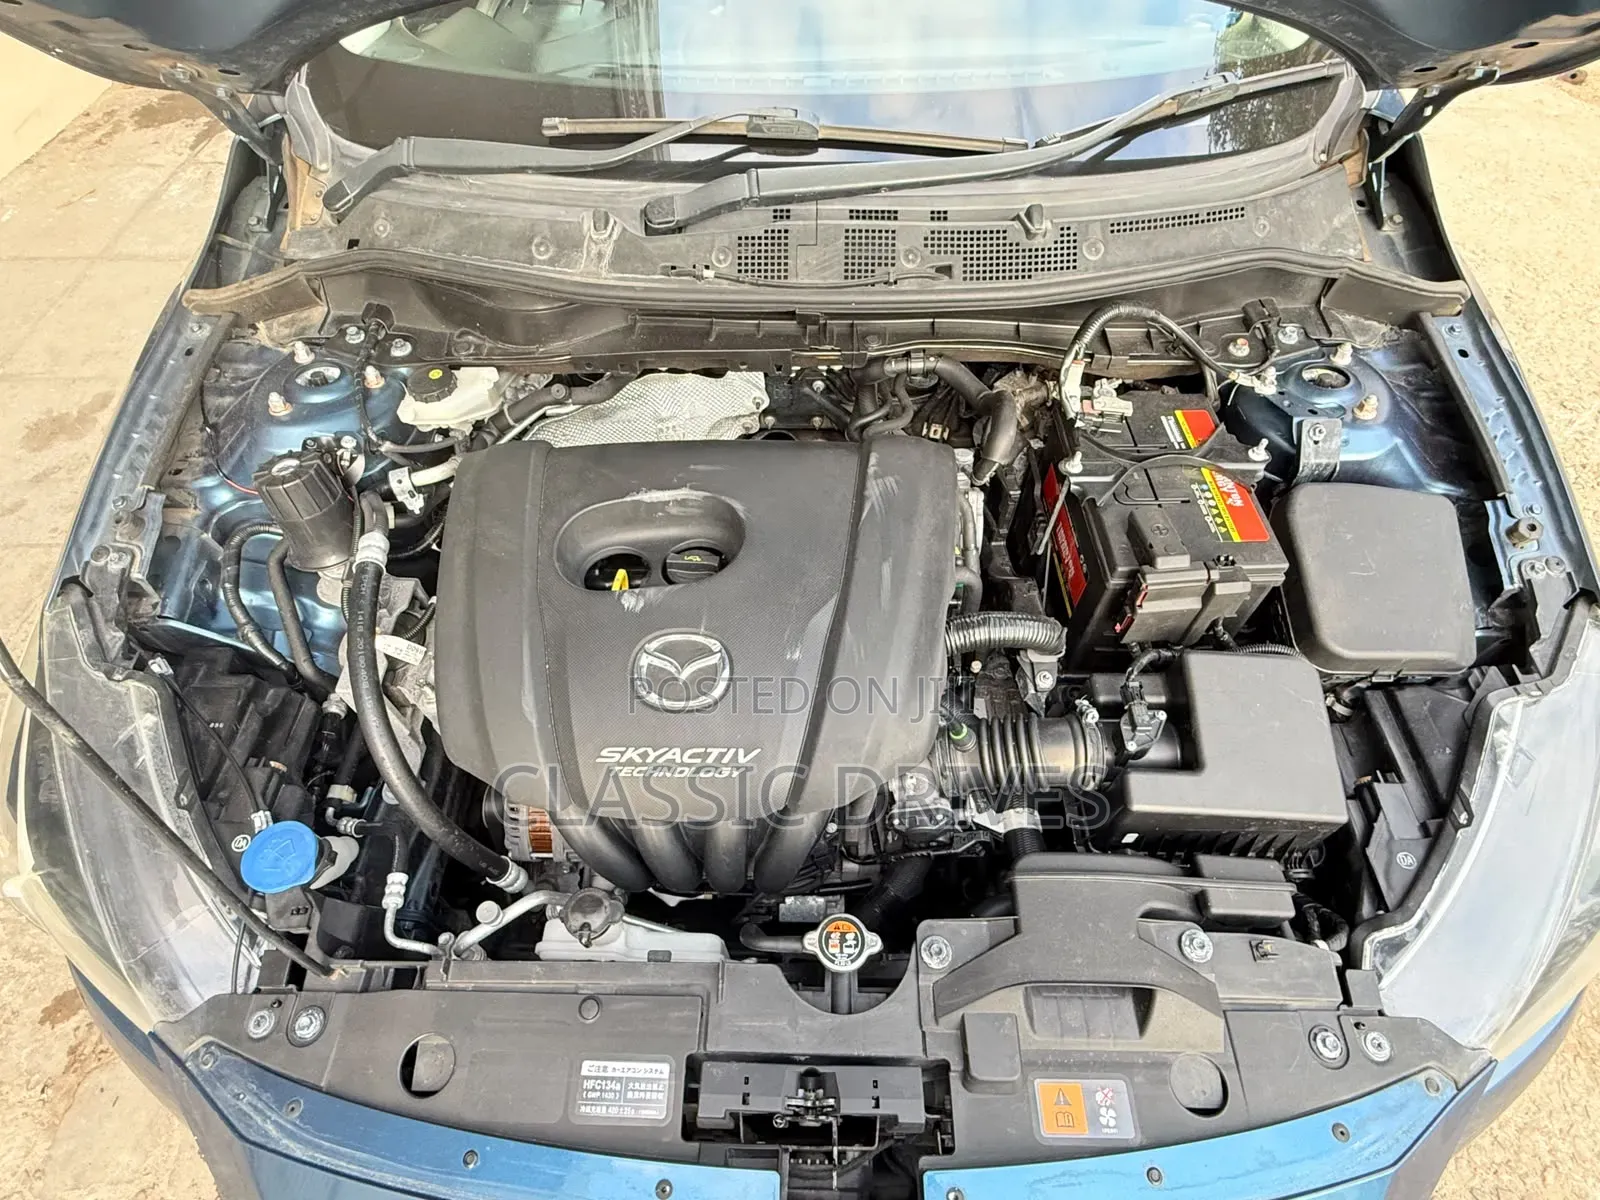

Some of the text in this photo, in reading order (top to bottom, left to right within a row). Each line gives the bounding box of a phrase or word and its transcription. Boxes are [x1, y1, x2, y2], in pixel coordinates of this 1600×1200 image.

[595, 747, 762, 764] SKYACTIV
[609, 766, 746, 778] TECHNOLOGY
[583, 1079, 621, 1091] HFC134a
